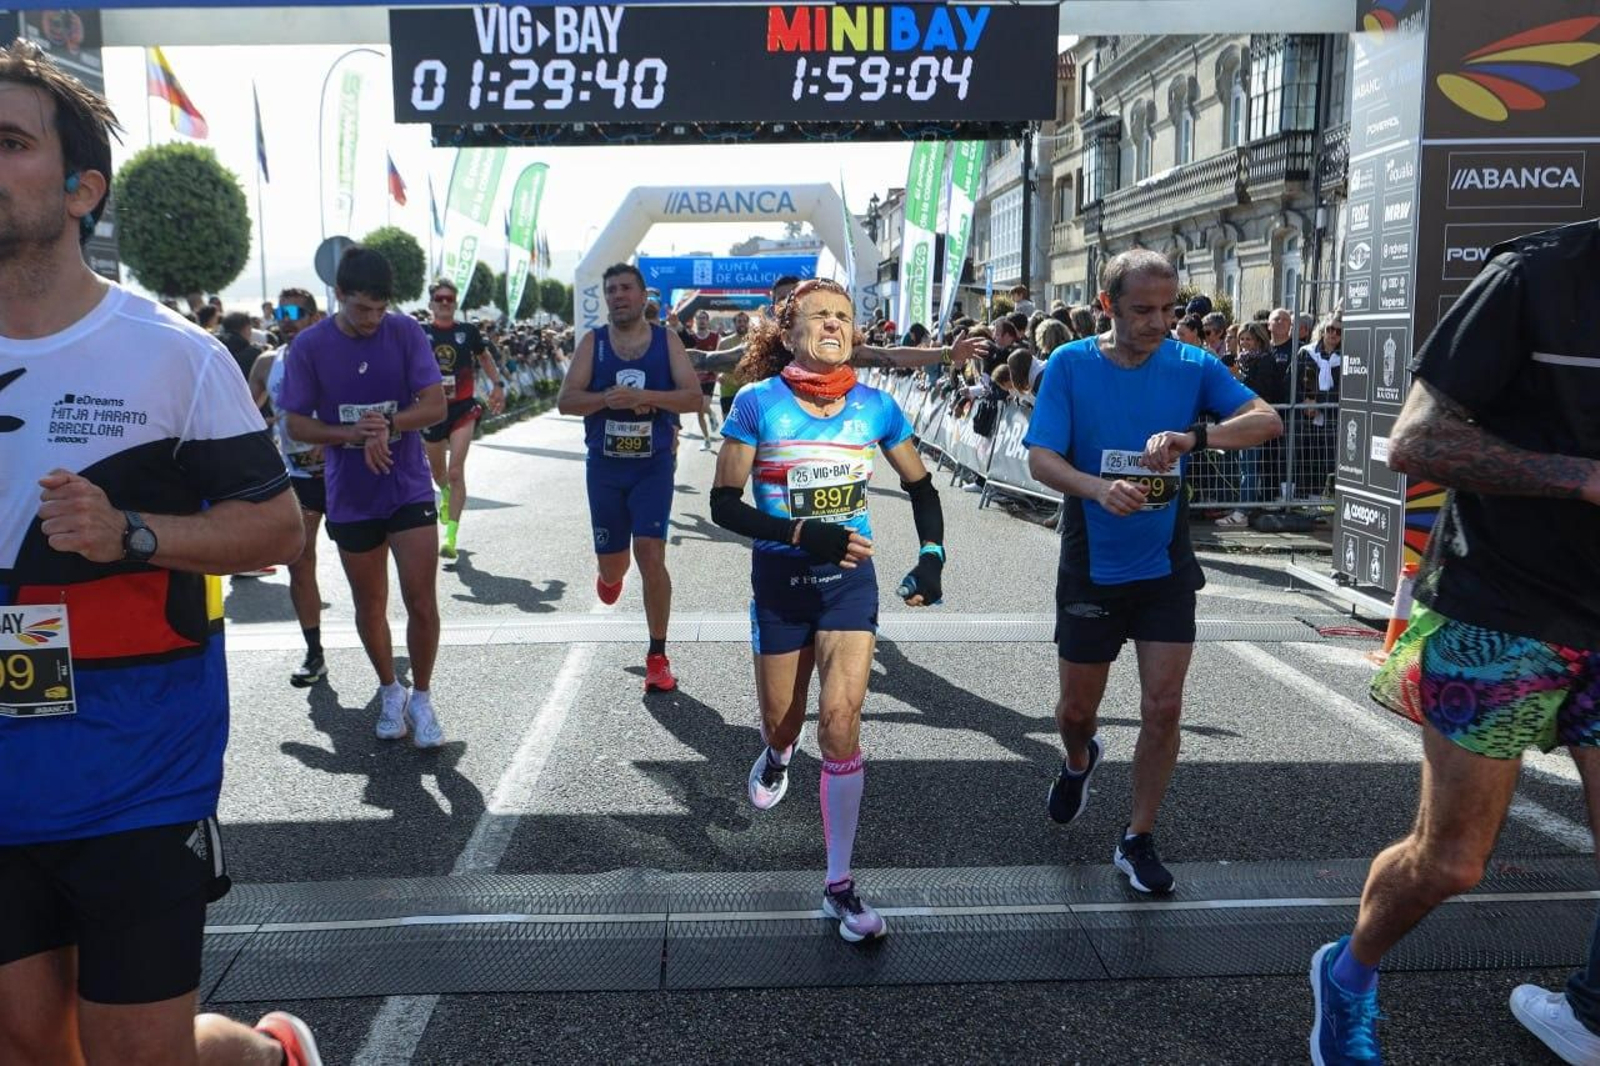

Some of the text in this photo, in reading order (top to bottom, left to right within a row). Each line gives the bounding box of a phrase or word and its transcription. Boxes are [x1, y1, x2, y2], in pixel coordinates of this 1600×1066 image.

[792, 56, 973, 101] 1:59:04
[1385, 201, 1411, 222] MRW
[717, 262, 759, 271] XUNTA
[716, 274, 730, 283] DE
[76, 395, 124, 406] eDreams
[51, 407, 89, 420] MITJA
[49, 421, 124, 437] BARCELONA
[616, 437, 642, 449] 299
[797, 470, 808, 482] 25
[814, 485, 854, 509] 897
